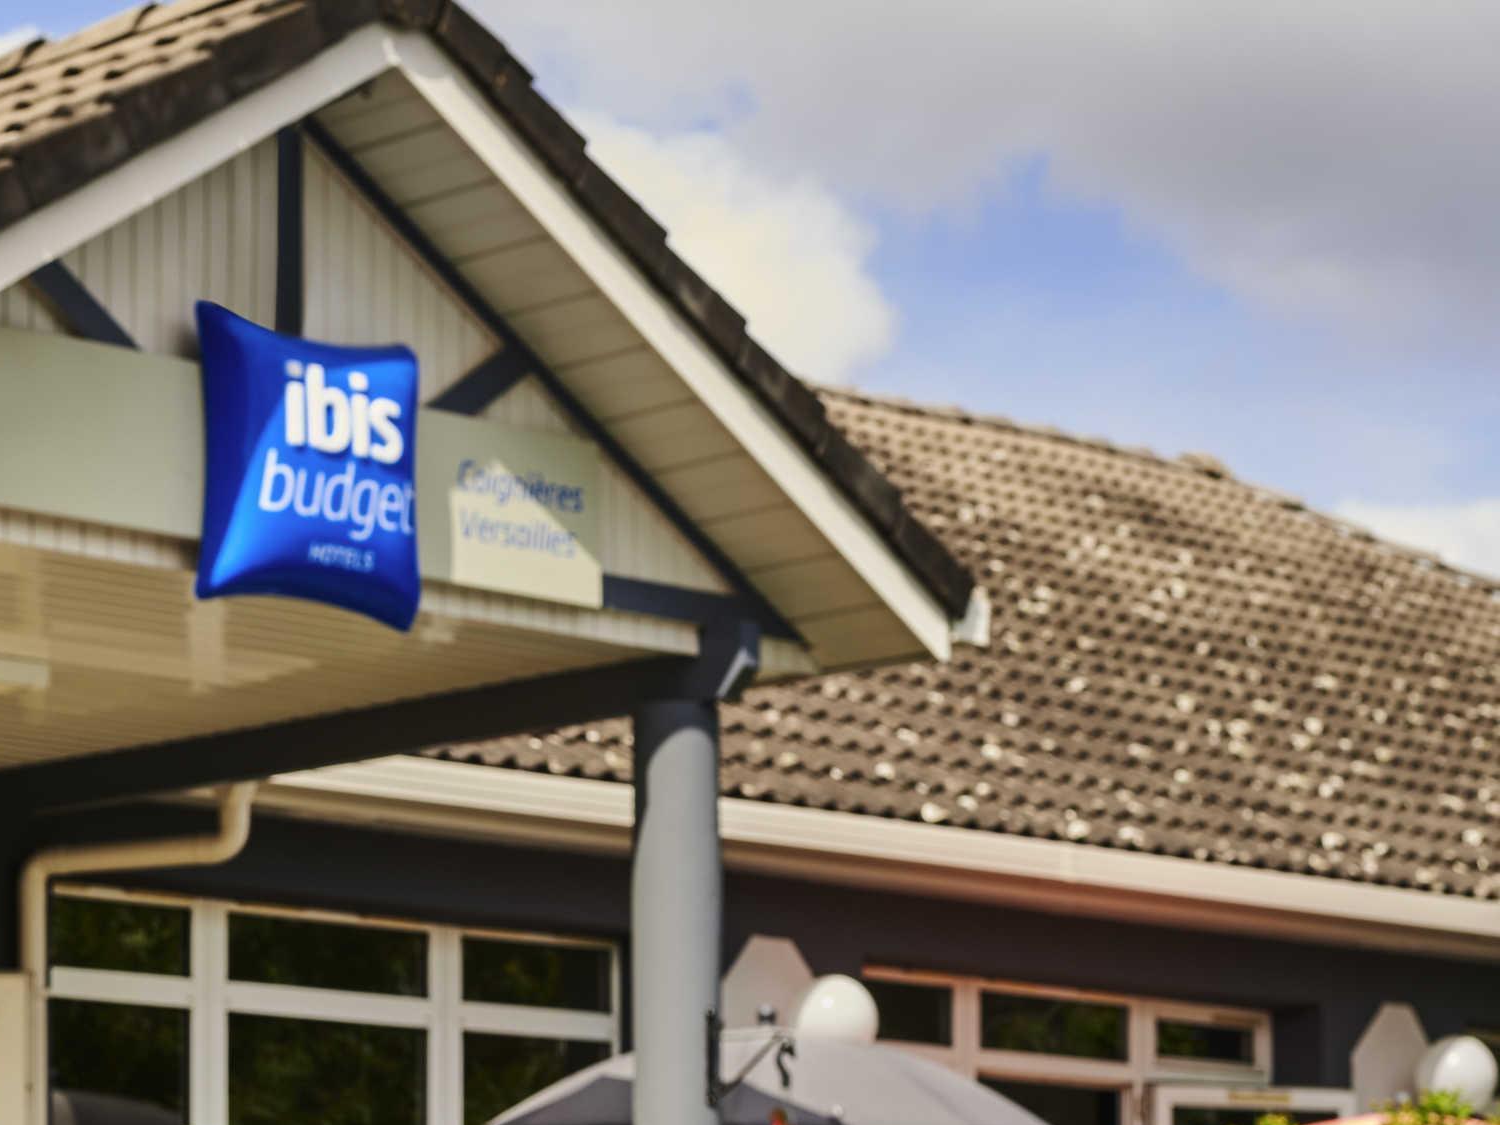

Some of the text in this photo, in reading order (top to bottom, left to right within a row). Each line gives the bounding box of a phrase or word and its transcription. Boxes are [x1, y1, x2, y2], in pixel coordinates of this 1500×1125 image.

[285, 359, 404, 465] ibis
[258, 448, 415, 541] budget
[309, 543, 375, 572] HOTELS
[459, 509, 577, 560] Versailles
